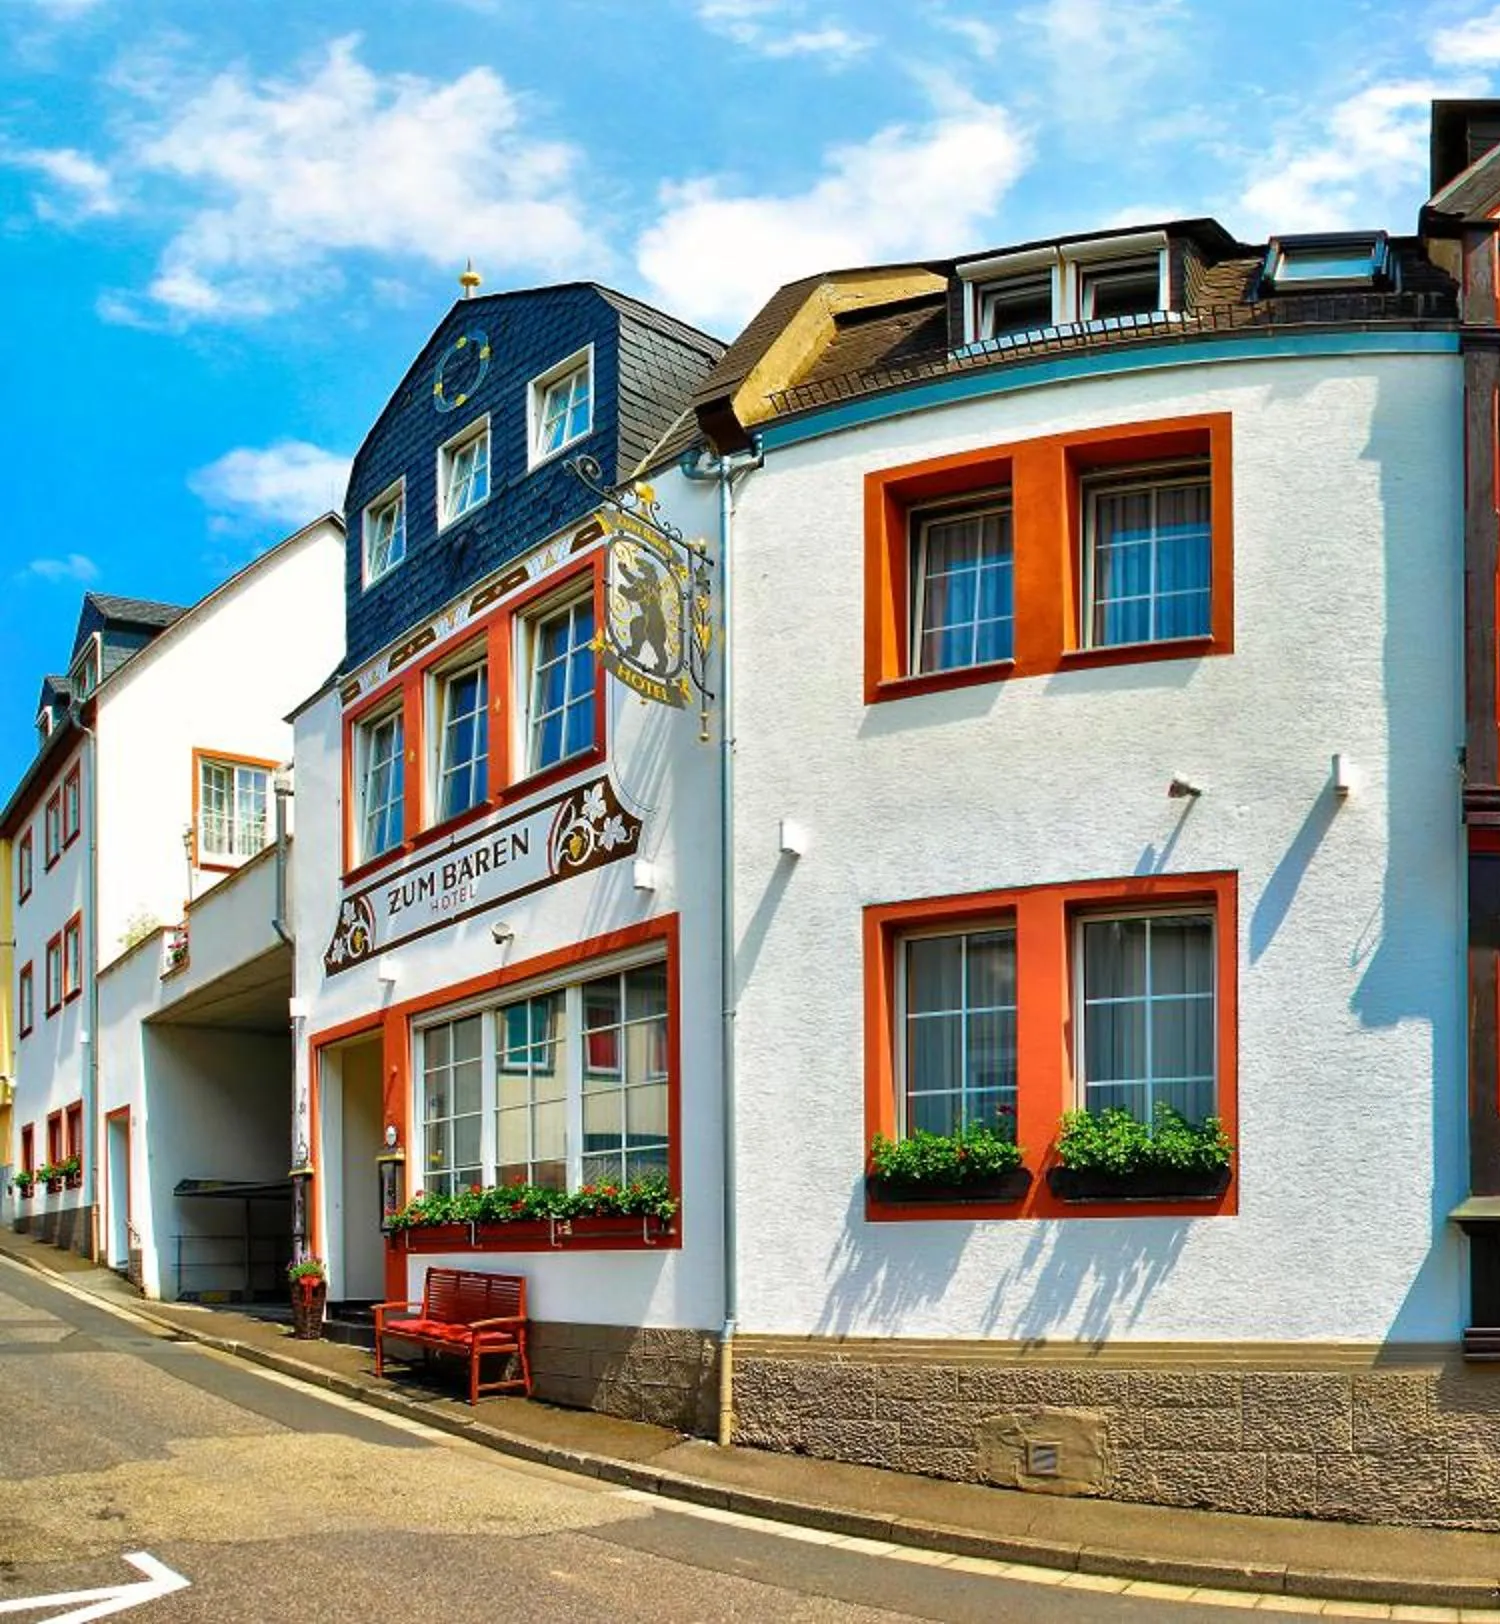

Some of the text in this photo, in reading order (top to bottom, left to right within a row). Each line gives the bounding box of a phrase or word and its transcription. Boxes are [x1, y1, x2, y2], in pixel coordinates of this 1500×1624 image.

[616, 663, 672, 703] HOTEL
[387, 827, 529, 916] ZUM BÄREN
[431, 884, 476, 913] HOTEL
